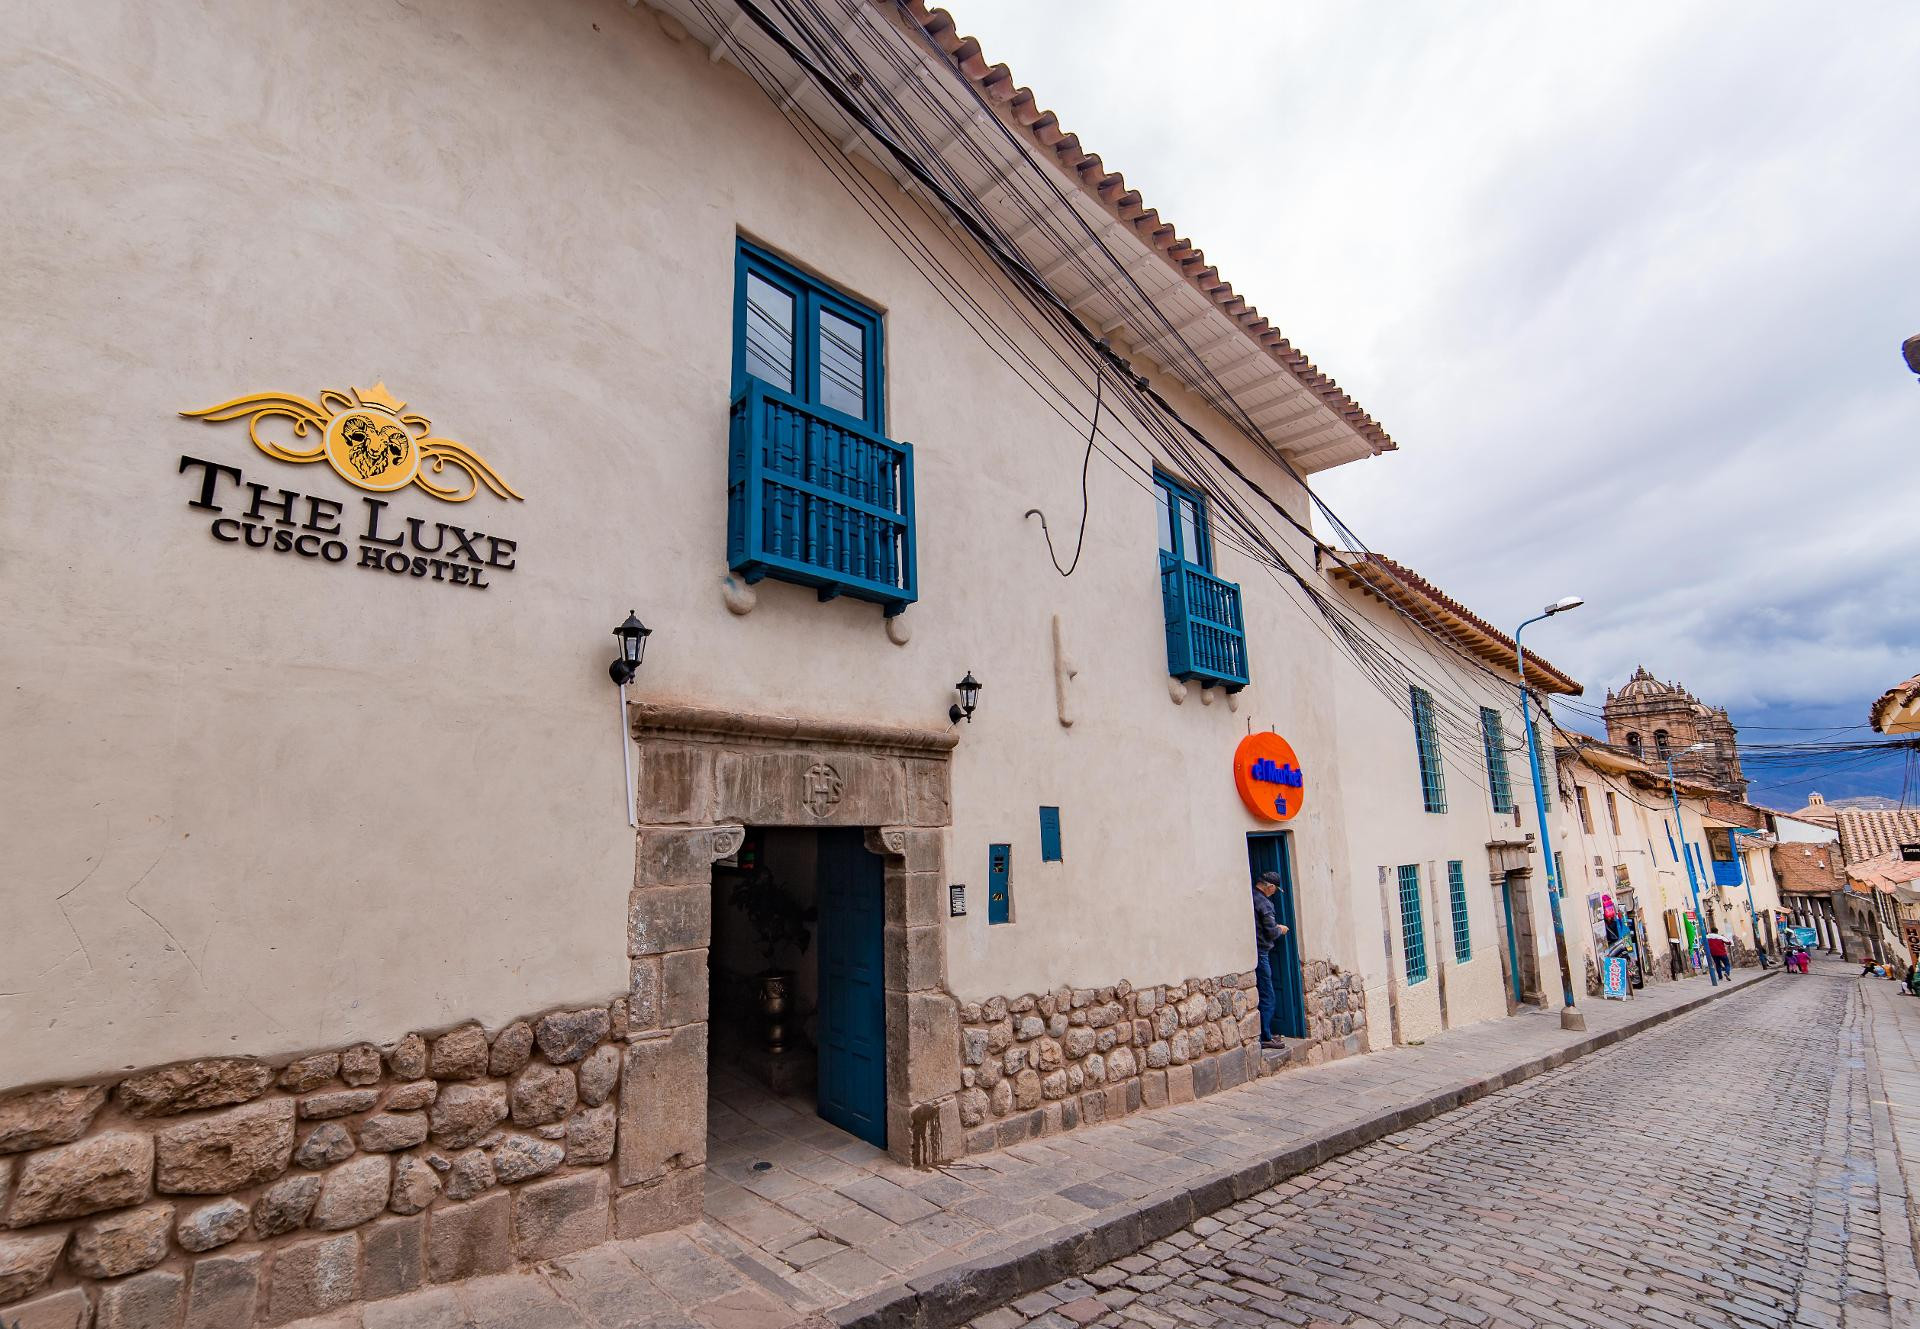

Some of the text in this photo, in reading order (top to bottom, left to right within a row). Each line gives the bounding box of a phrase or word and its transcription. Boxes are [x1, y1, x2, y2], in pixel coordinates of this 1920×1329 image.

[179, 455, 517, 570] THE LUXE
[211, 518, 490, 589] CUSCO HOSTEL
